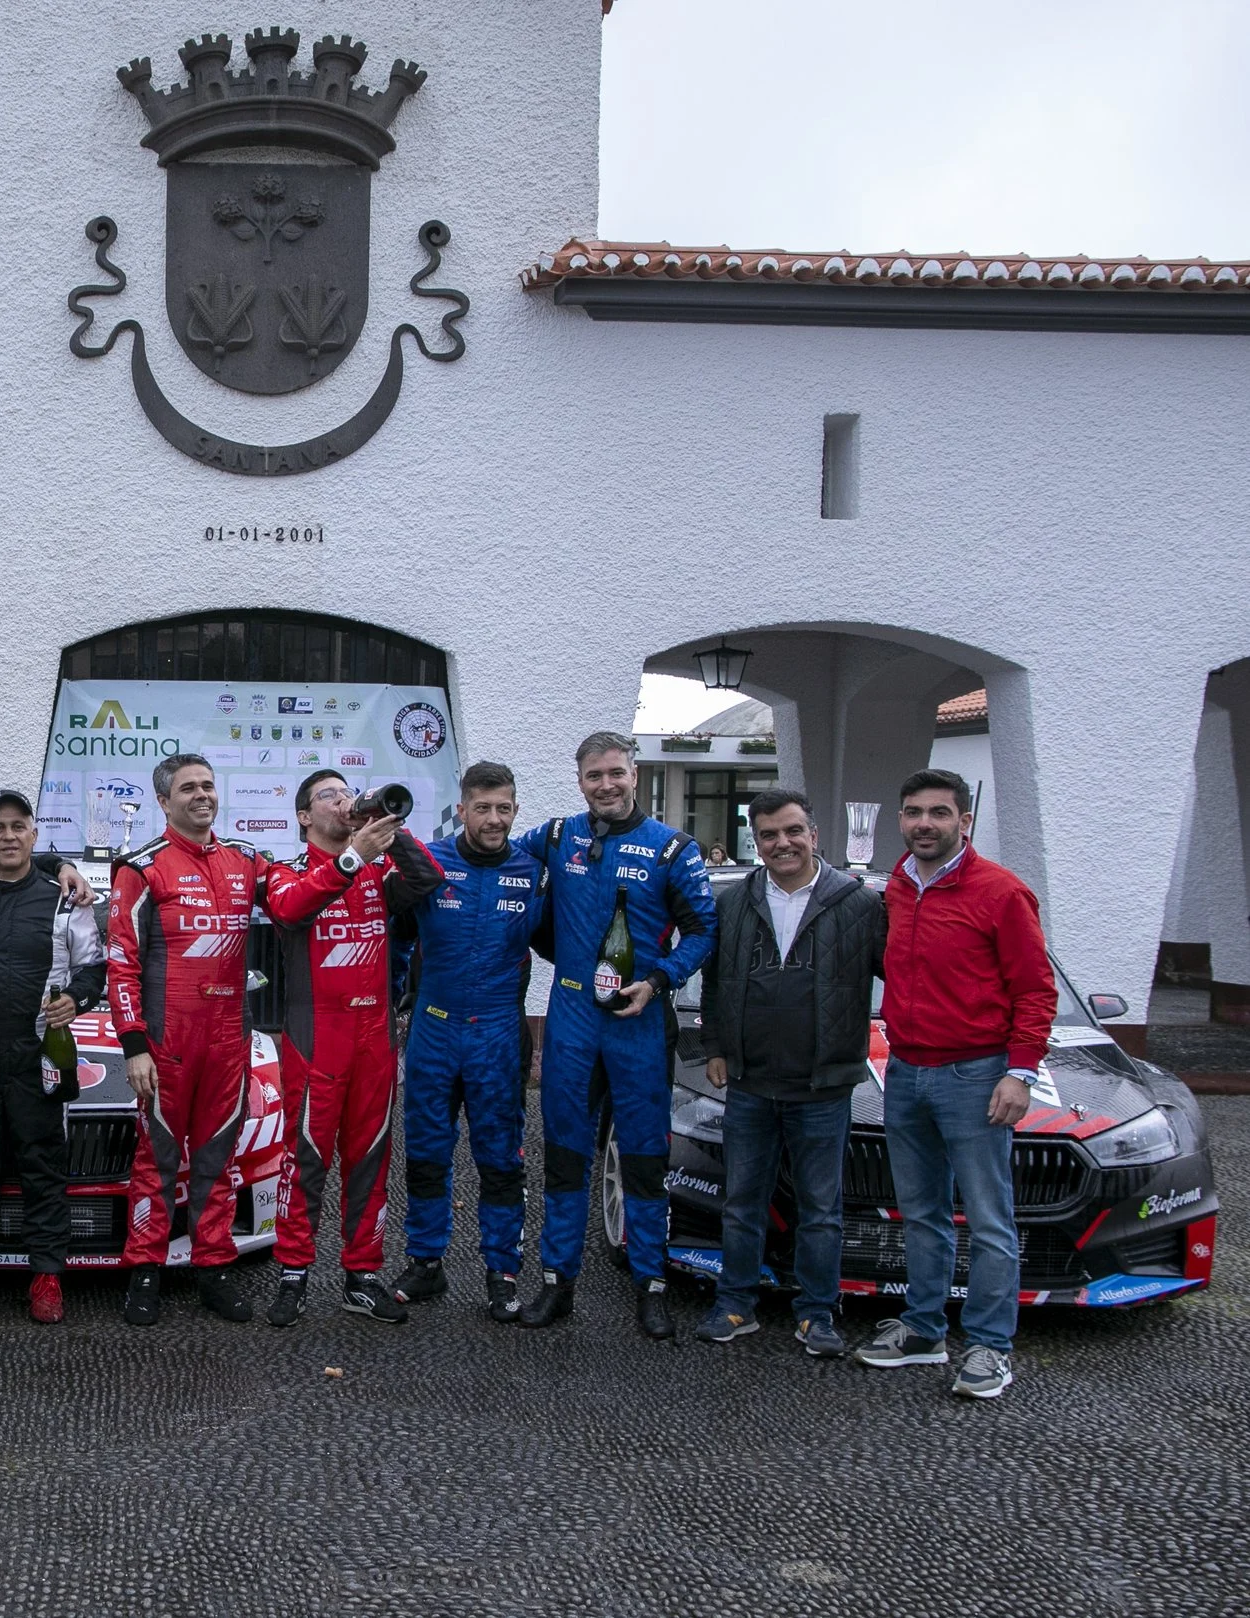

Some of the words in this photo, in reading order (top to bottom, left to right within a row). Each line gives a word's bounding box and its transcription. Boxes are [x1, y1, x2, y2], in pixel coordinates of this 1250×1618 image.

[205, 526, 325, 542] 01-01-2001
[70, 700, 158, 730] RALI
[394, 706, 411, 731] DESIGN
[421, 703, 447, 738] MARKETING
[54, 733, 180, 758] Santana
[397, 738, 440, 757] PUBLICIDADE
[340, 757, 367, 766] CORAL
[249, 821, 286, 829] CASSIANOS
[619, 844, 655, 858] ZEISS
[497, 876, 531, 888] ZEISS
[616, 866, 649, 882] MEO
[496, 899, 526, 912] MEO
[180, 914, 249, 931] LOTES
[315, 919, 386, 941] LOTES
[65, 1255, 122, 1266] virtualcar
[1098, 1286, 1133, 1302] Alberto
